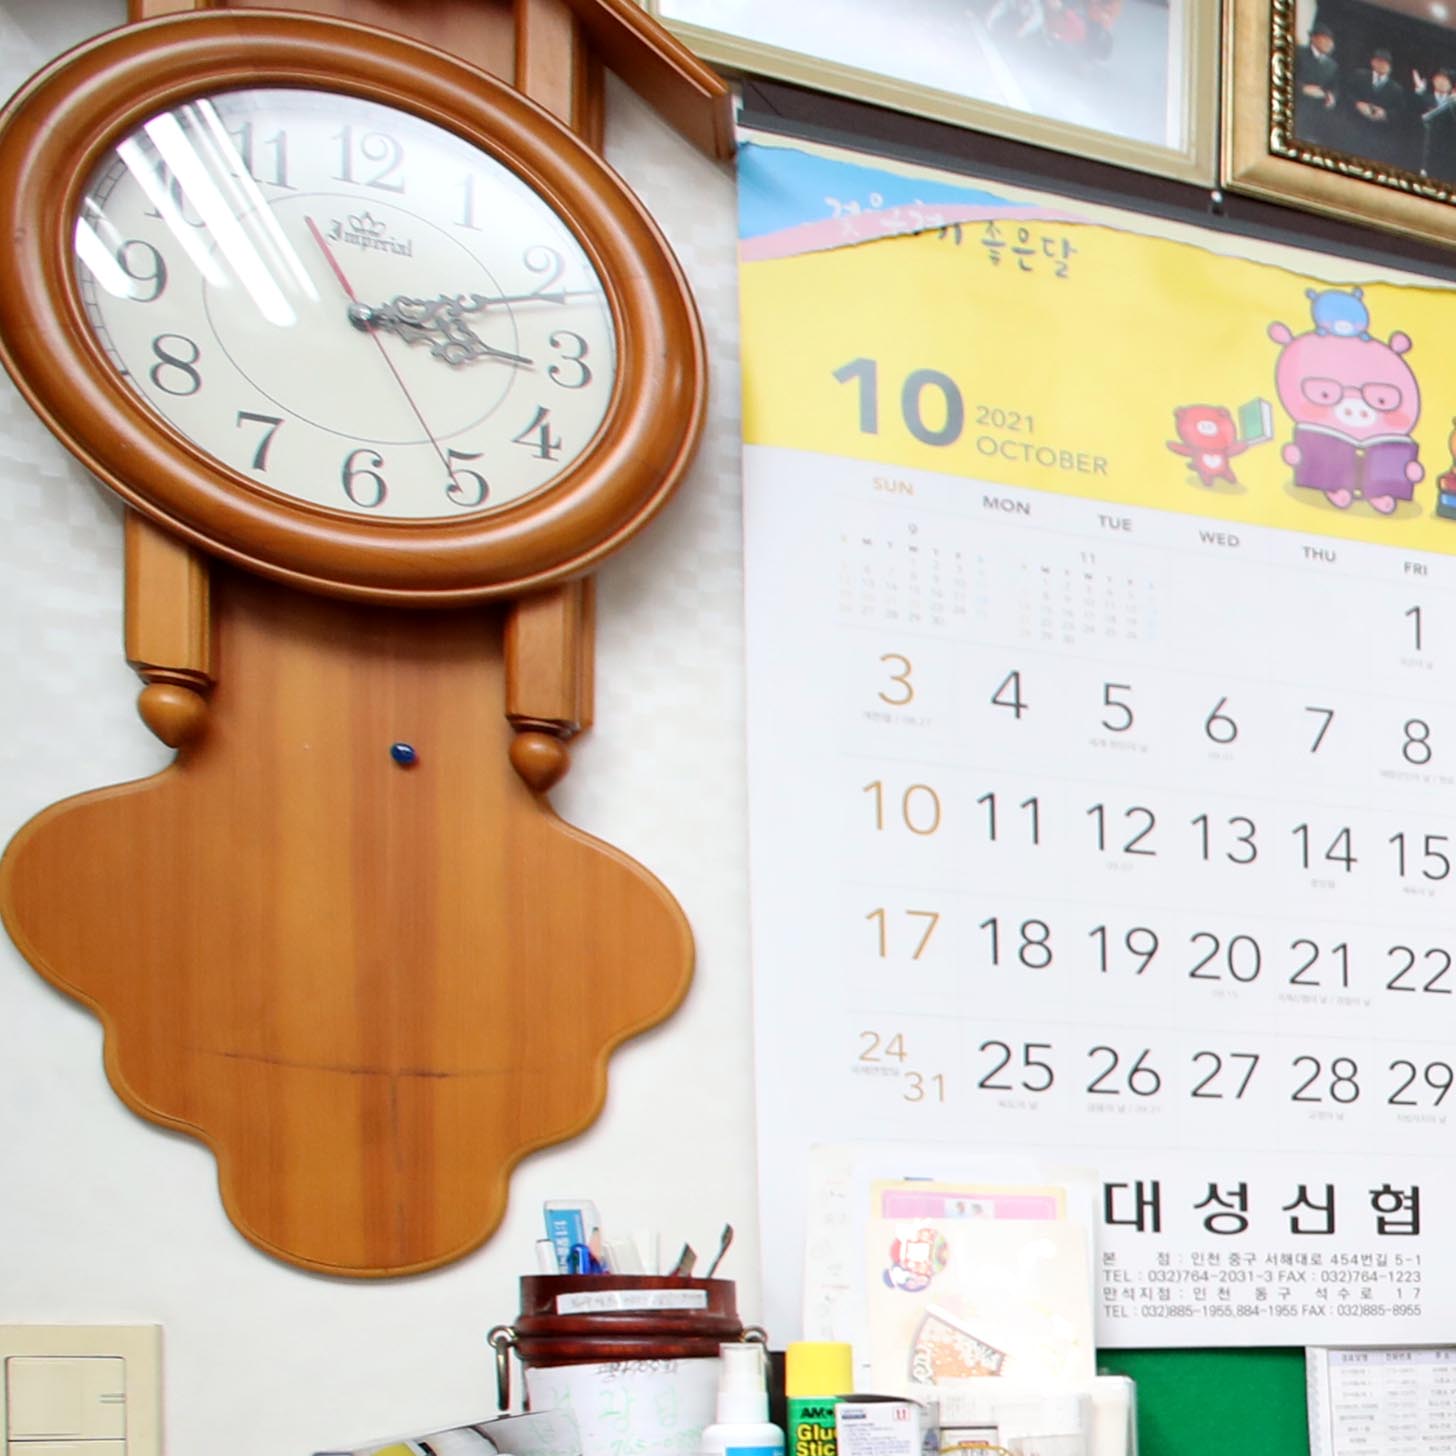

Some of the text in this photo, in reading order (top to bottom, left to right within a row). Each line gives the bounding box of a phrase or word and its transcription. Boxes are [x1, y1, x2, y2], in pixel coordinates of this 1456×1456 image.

[231, 121, 297, 189] 11
[331, 124, 406, 193] 12
[455, 172, 483, 230] 1
[328, 216, 414, 258] Imperial
[118, 240, 168, 302] 9
[523, 245, 566, 304] 2
[150, 334, 201, 396] 8
[548, 331, 591, 389] 3
[832, 357, 965, 447] 10
[976, 405, 1036, 434] 2021
[237, 411, 284, 470] 7
[512, 406, 562, 461] 4
[977, 436, 1109, 476] OCTOBER
[342, 448, 387, 507] 6
[447, 449, 489, 506] 5
[873, 476, 914, 496] SUN
[983, 496, 1031, 516] MON
[1099, 515, 1132, 532] TUE
[1199, 530, 1240, 548] WED
[1303, 546, 1336, 562] THU
[1404, 562, 1429, 576] FRI
[1405, 606, 1421, 650] 1
[878, 653, 914, 706] 3
[991, 671, 1028, 719] 4
[1101, 683, 1133, 731] 5
[1204, 697, 1238, 744] 6
[1305, 706, 1334, 753] 7
[1402, 719, 1432, 765] 8
[863, 780, 941, 836] 10
[976, 793, 1039, 845] 11
[1086, 803, 1156, 856] 12
[1190, 814, 1258, 864] 13
[1291, 823, 1358, 873] 14
[1388, 833, 1451, 880] 15
[865, 908, 940, 960] 17
[979, 917, 1053, 968] 18
[1088, 925, 1159, 975] 19
[1188, 932, 1262, 982] 20
[1289, 939, 1349, 988] 21
[1386, 946, 1453, 994] 22
[858, 1031, 908, 1063] 24
[977, 1040, 1054, 1092] 25
[1087, 1046, 1161, 1096] 26
[1191, 1051, 1260, 1099] 27
[1291, 1055, 1360, 1104] 28
[1388, 1060, 1454, 1107] 29
[902, 1071, 946, 1102] 31
[1102, 1180, 1422, 1236] 대성신협
[1103, 1269, 1422, 1285] TEL 032)764-2031-3 FAX 032)764-1223
[1191, 1251, 1221, 1267] 인천
[1227, 1252, 1258, 1267] 중구
[1263, 1252, 1323, 1267] 서해대로
[1330, 1252, 1389, 1267] 454번길
[1394, 1253, 1422, 1267] 5-1
[1104, 1305, 1129, 1318] TEL
[1301, 1304, 1327, 1318] FAX
[1336, 1303, 1422, 1319] 032)885-8955
